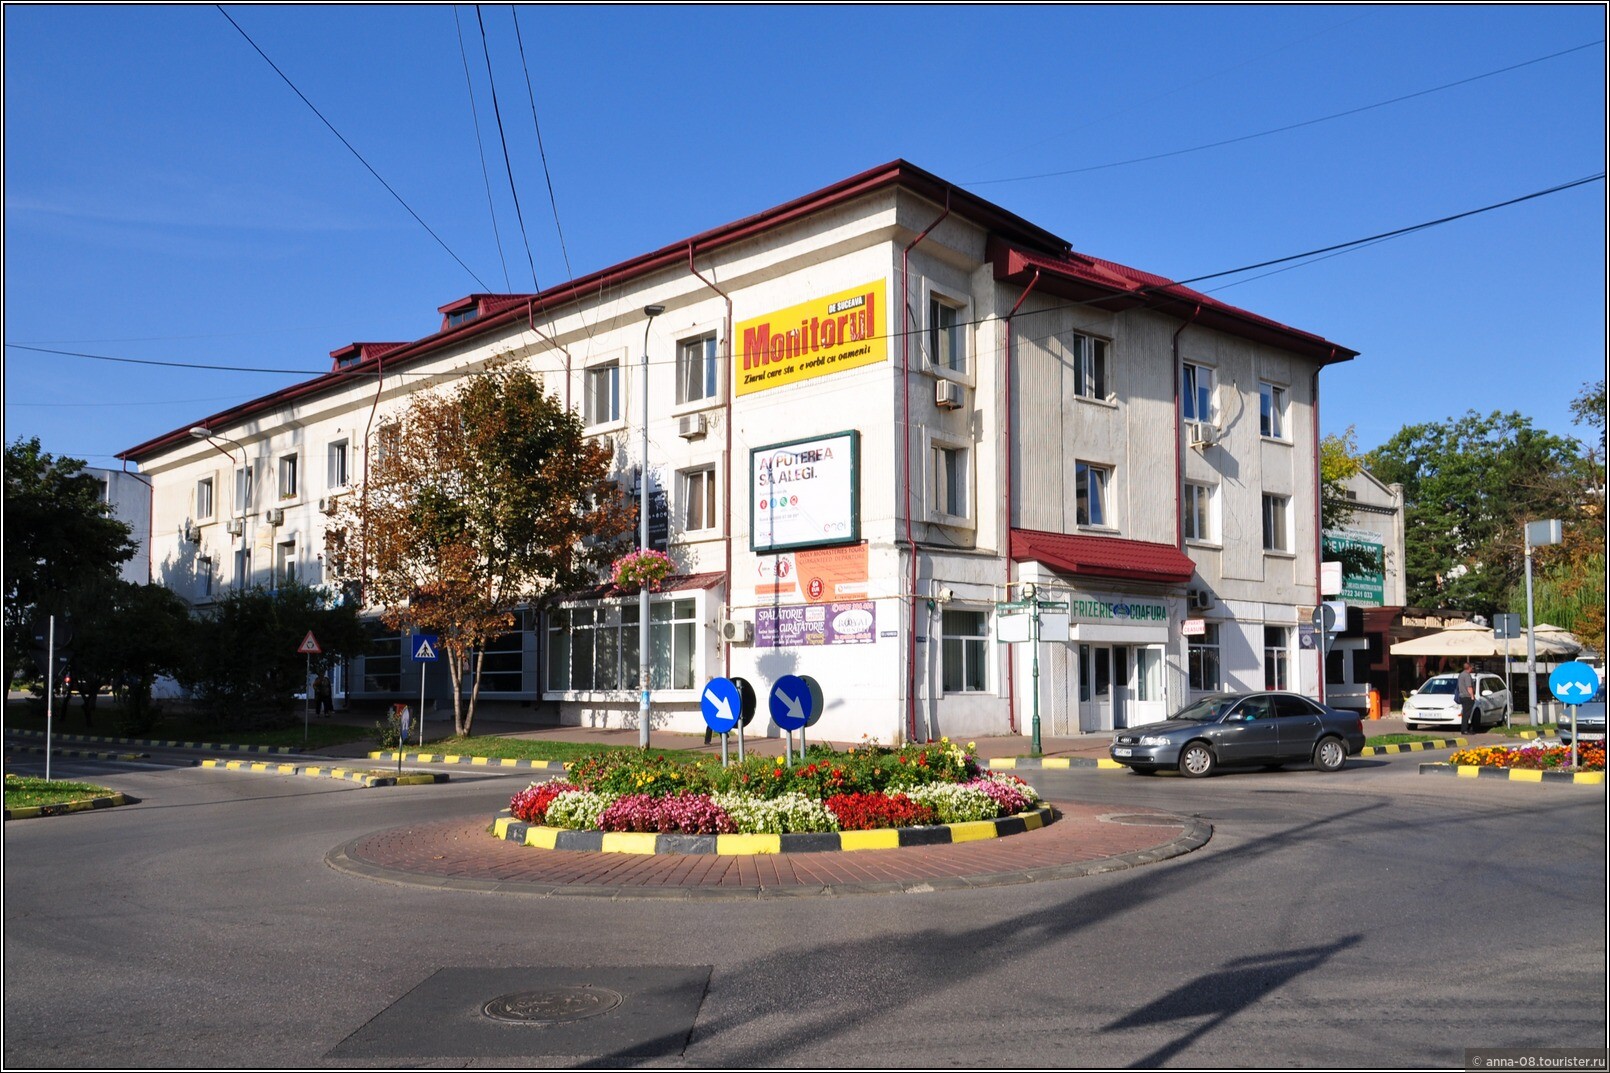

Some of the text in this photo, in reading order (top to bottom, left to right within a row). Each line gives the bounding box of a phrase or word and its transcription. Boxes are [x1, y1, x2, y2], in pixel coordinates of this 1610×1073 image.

[828, 296, 863, 314] DE SUCEAVA
[743, 292, 875, 371] Monitorul
[744, 370, 766, 384] Ziarul
[767, 368, 782, 380] care
[826, 354, 836, 366] cu
[760, 447, 834, 470] AI PUTEREA
[778, 466, 818, 484] ALEGI.
[1073, 600, 1167, 622] FRIZERIE COAFURA
